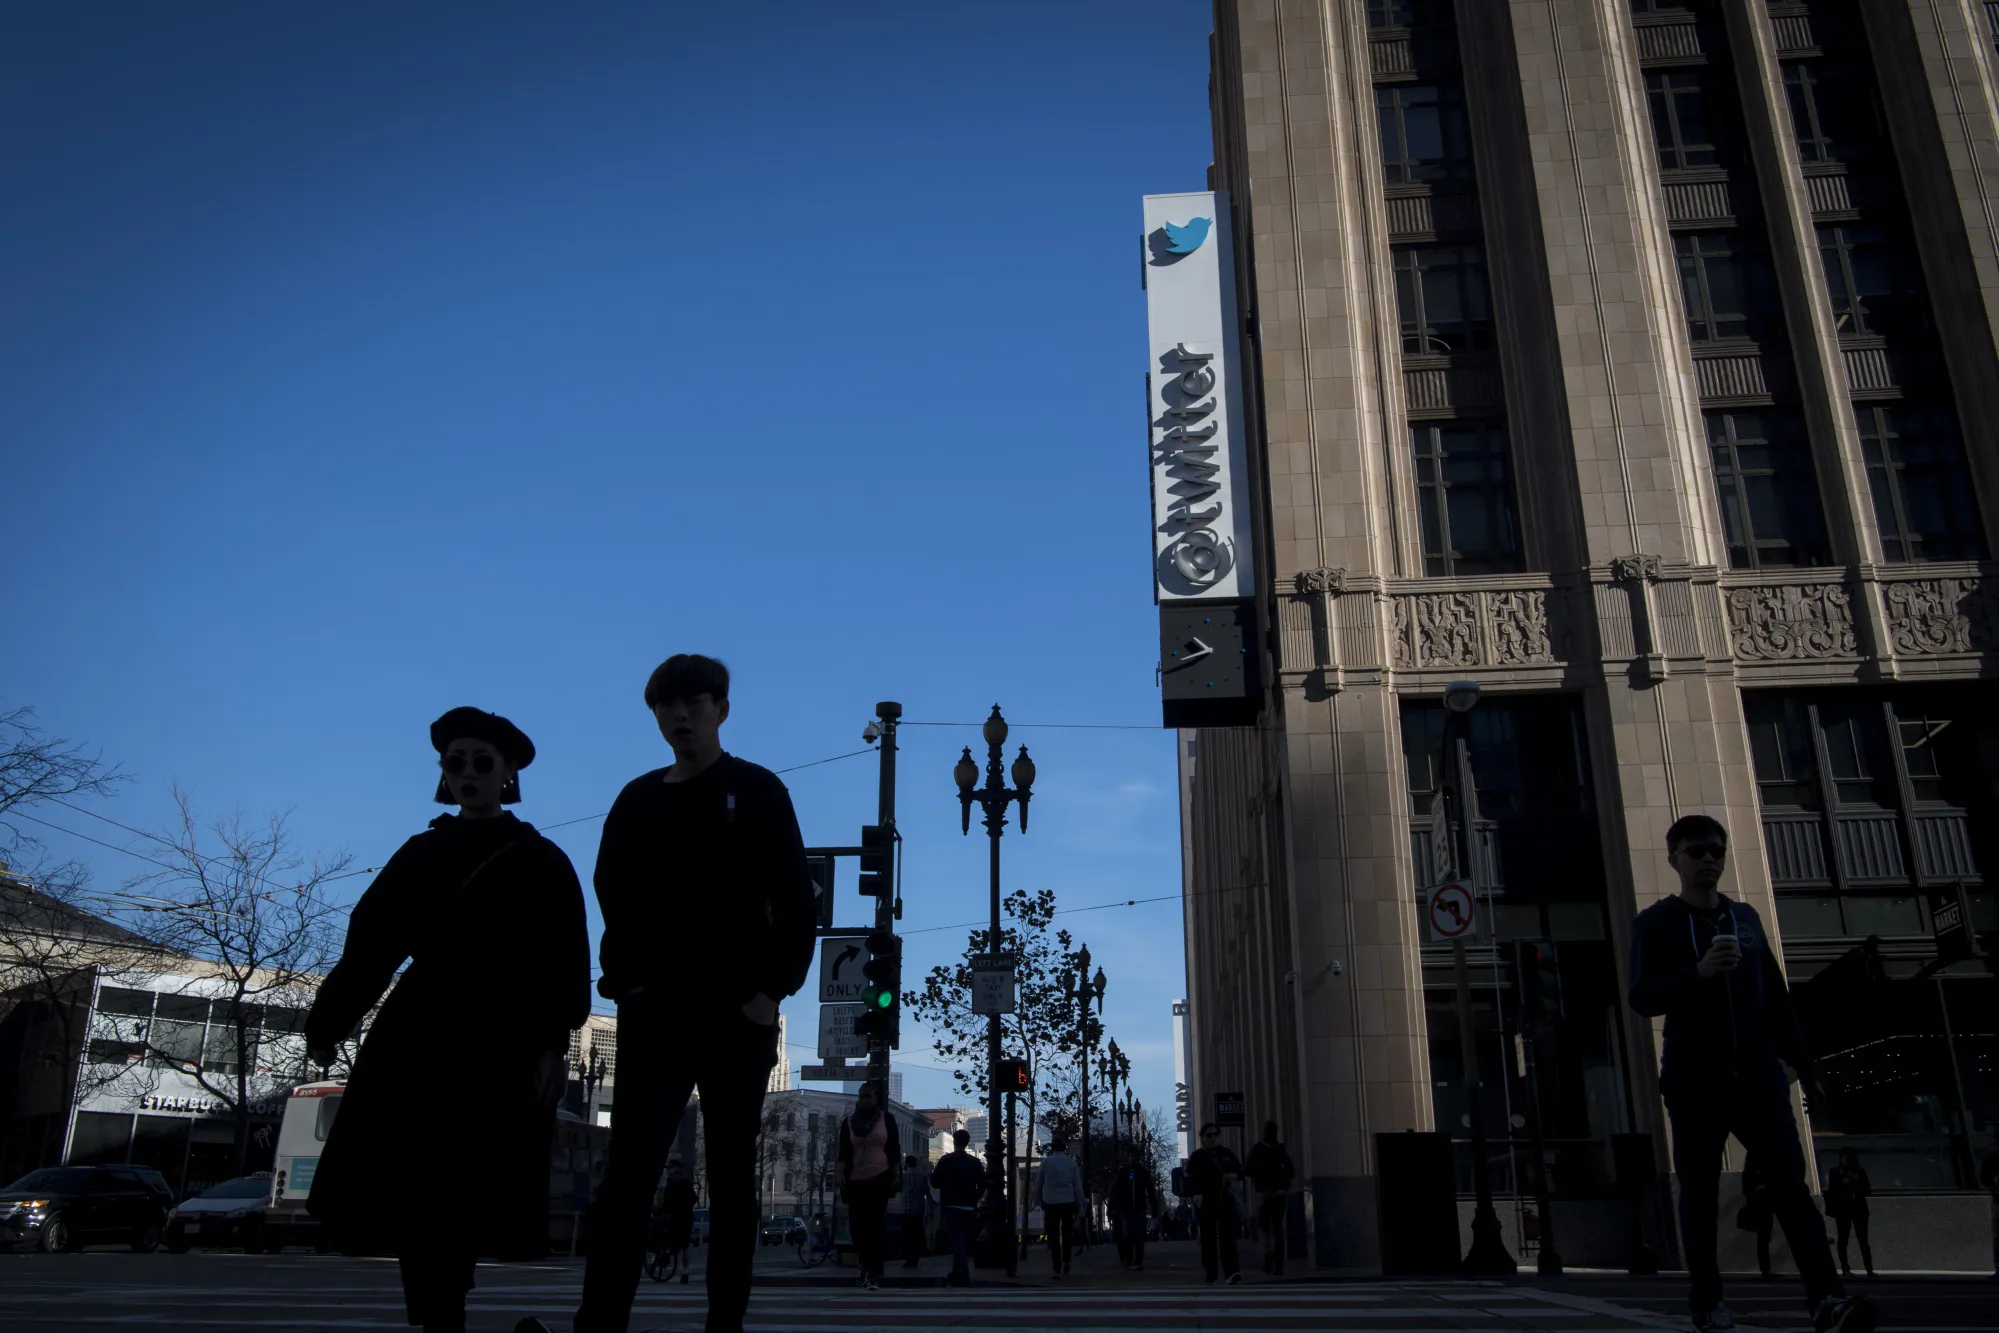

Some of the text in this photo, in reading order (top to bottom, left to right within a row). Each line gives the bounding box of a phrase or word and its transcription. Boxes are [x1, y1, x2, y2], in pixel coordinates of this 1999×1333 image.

[1170, 342, 1236, 585] @twitter
[1436, 835, 1449, 874] 25
[1933, 906, 1960, 932] MARKET
[827, 984, 861, 997] ONLY
[983, 993, 1003, 1001] ONLY
[833, 1006, 855, 1015] EXCEPT
[833, 1017, 853, 1025] BUSES
[827, 1026, 853, 1035] BICYCLE
[836, 1047, 859, 1056] TRUCKS
[812, 1068, 856, 1078] 10TH ST
[142, 1094, 235, 1112] STARBUC
[1175, 1082, 1191, 1132] DOLBY
[1219, 1102, 1244, 1113] MARKET
